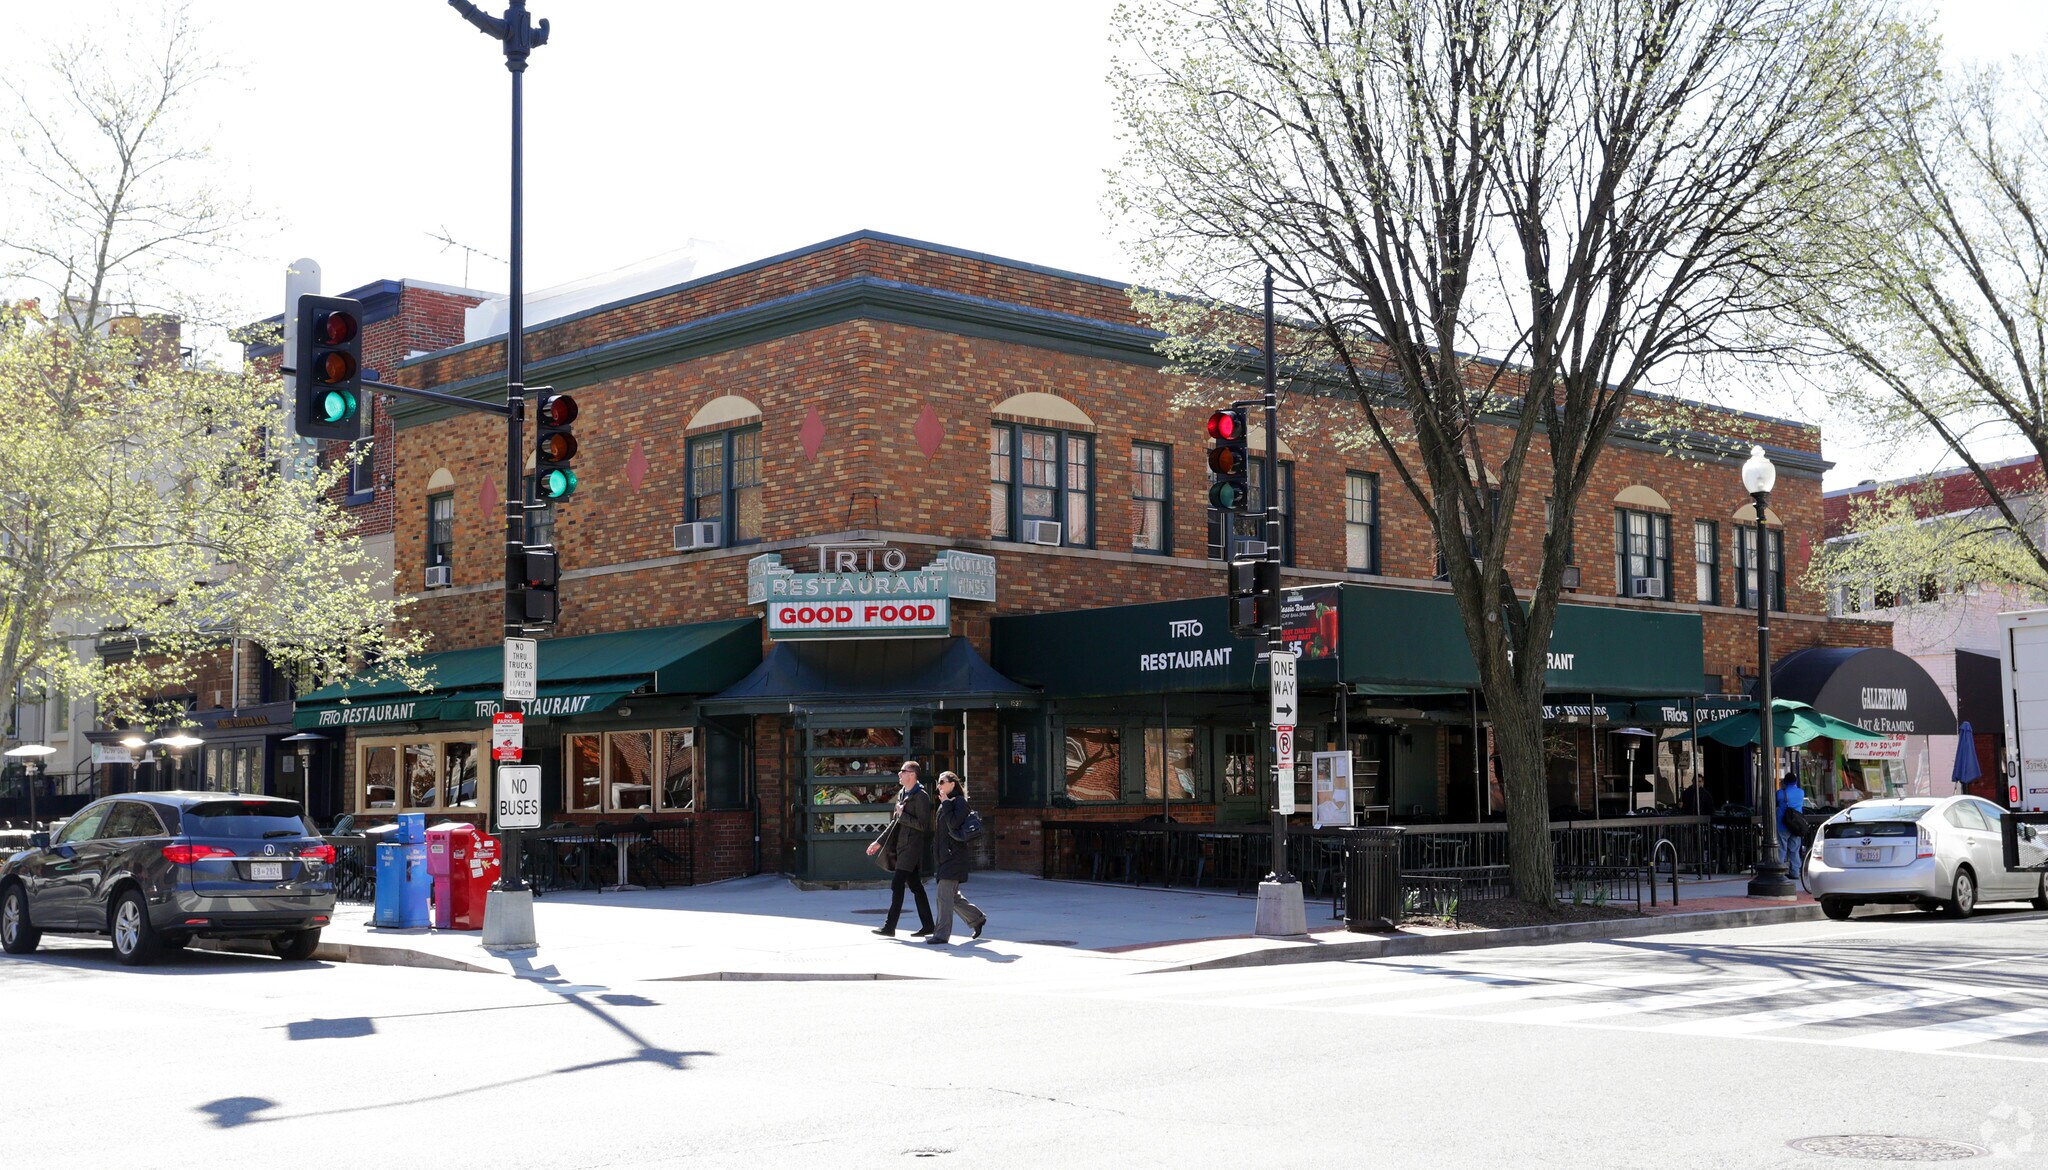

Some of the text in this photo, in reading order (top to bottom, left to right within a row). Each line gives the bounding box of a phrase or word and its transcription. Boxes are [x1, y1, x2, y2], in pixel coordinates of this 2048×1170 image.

[806, 541, 906, 574] TRIO
[773, 576, 943, 596] RESTAURANT
[779, 605, 935, 624] GOOD FOOD
[1295, 602, 1316, 612] Brunch
[1168, 619, 1204, 638] TRIO
[515, 643, 524, 651] NO
[1289, 640, 1303, 659] $5
[513, 652, 527, 660] THRU
[1140, 647, 1233, 671] RESTAURANT
[508, 661, 533, 670] TRUCKS
[1273, 661, 1294, 676] ONE
[514, 670, 526, 679] OVER
[1274, 681, 1294, 696] WAY
[475, 696, 590, 717] TRIO STAURANT
[1861, 687, 1908, 711] GALLERY 2000
[318, 702, 416, 725] TRIO RESTAURANT
[1711, 709, 1718, 722] &
[1857, 717, 1915, 732] ART & FRAMING
[511, 779, 528, 794] NO
[500, 800, 538, 816] BUSES
